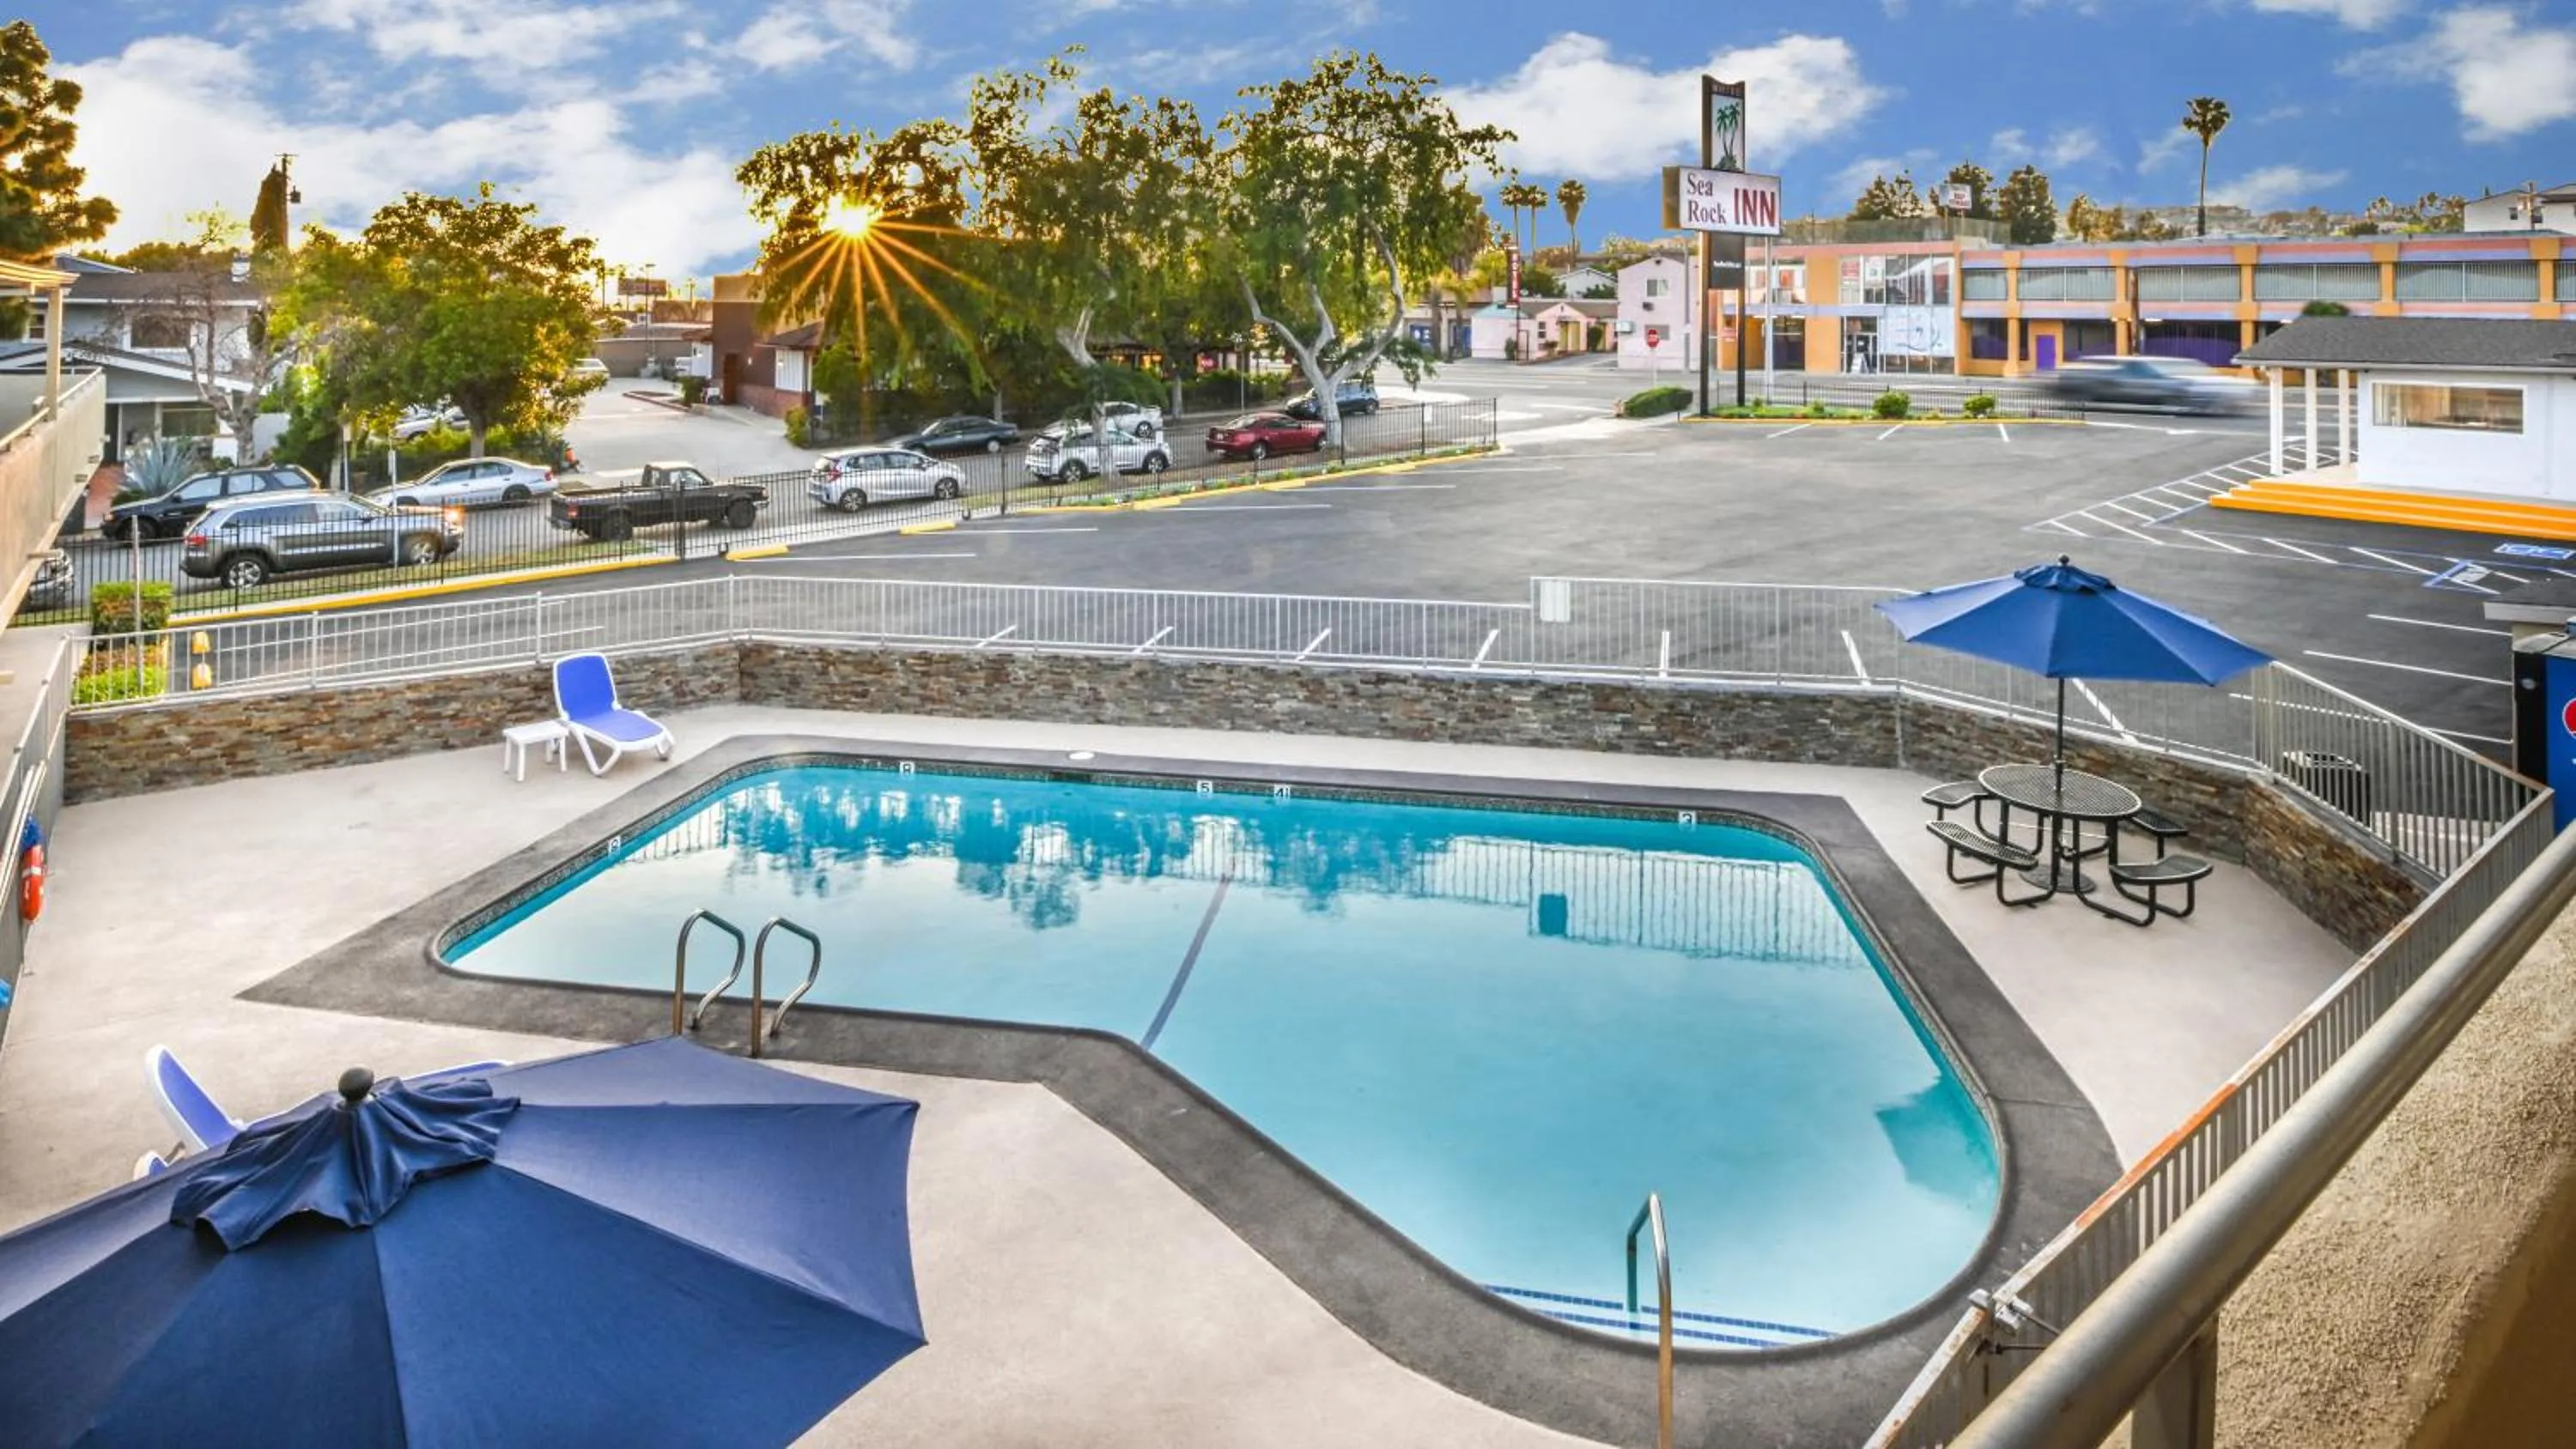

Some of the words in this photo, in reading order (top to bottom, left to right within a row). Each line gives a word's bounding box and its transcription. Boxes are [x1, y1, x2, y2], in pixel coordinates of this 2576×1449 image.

[1687, 173, 1713, 197] Sea
[1688, 200, 1726, 225] Rock
[1735, 188, 1776, 227] INN
